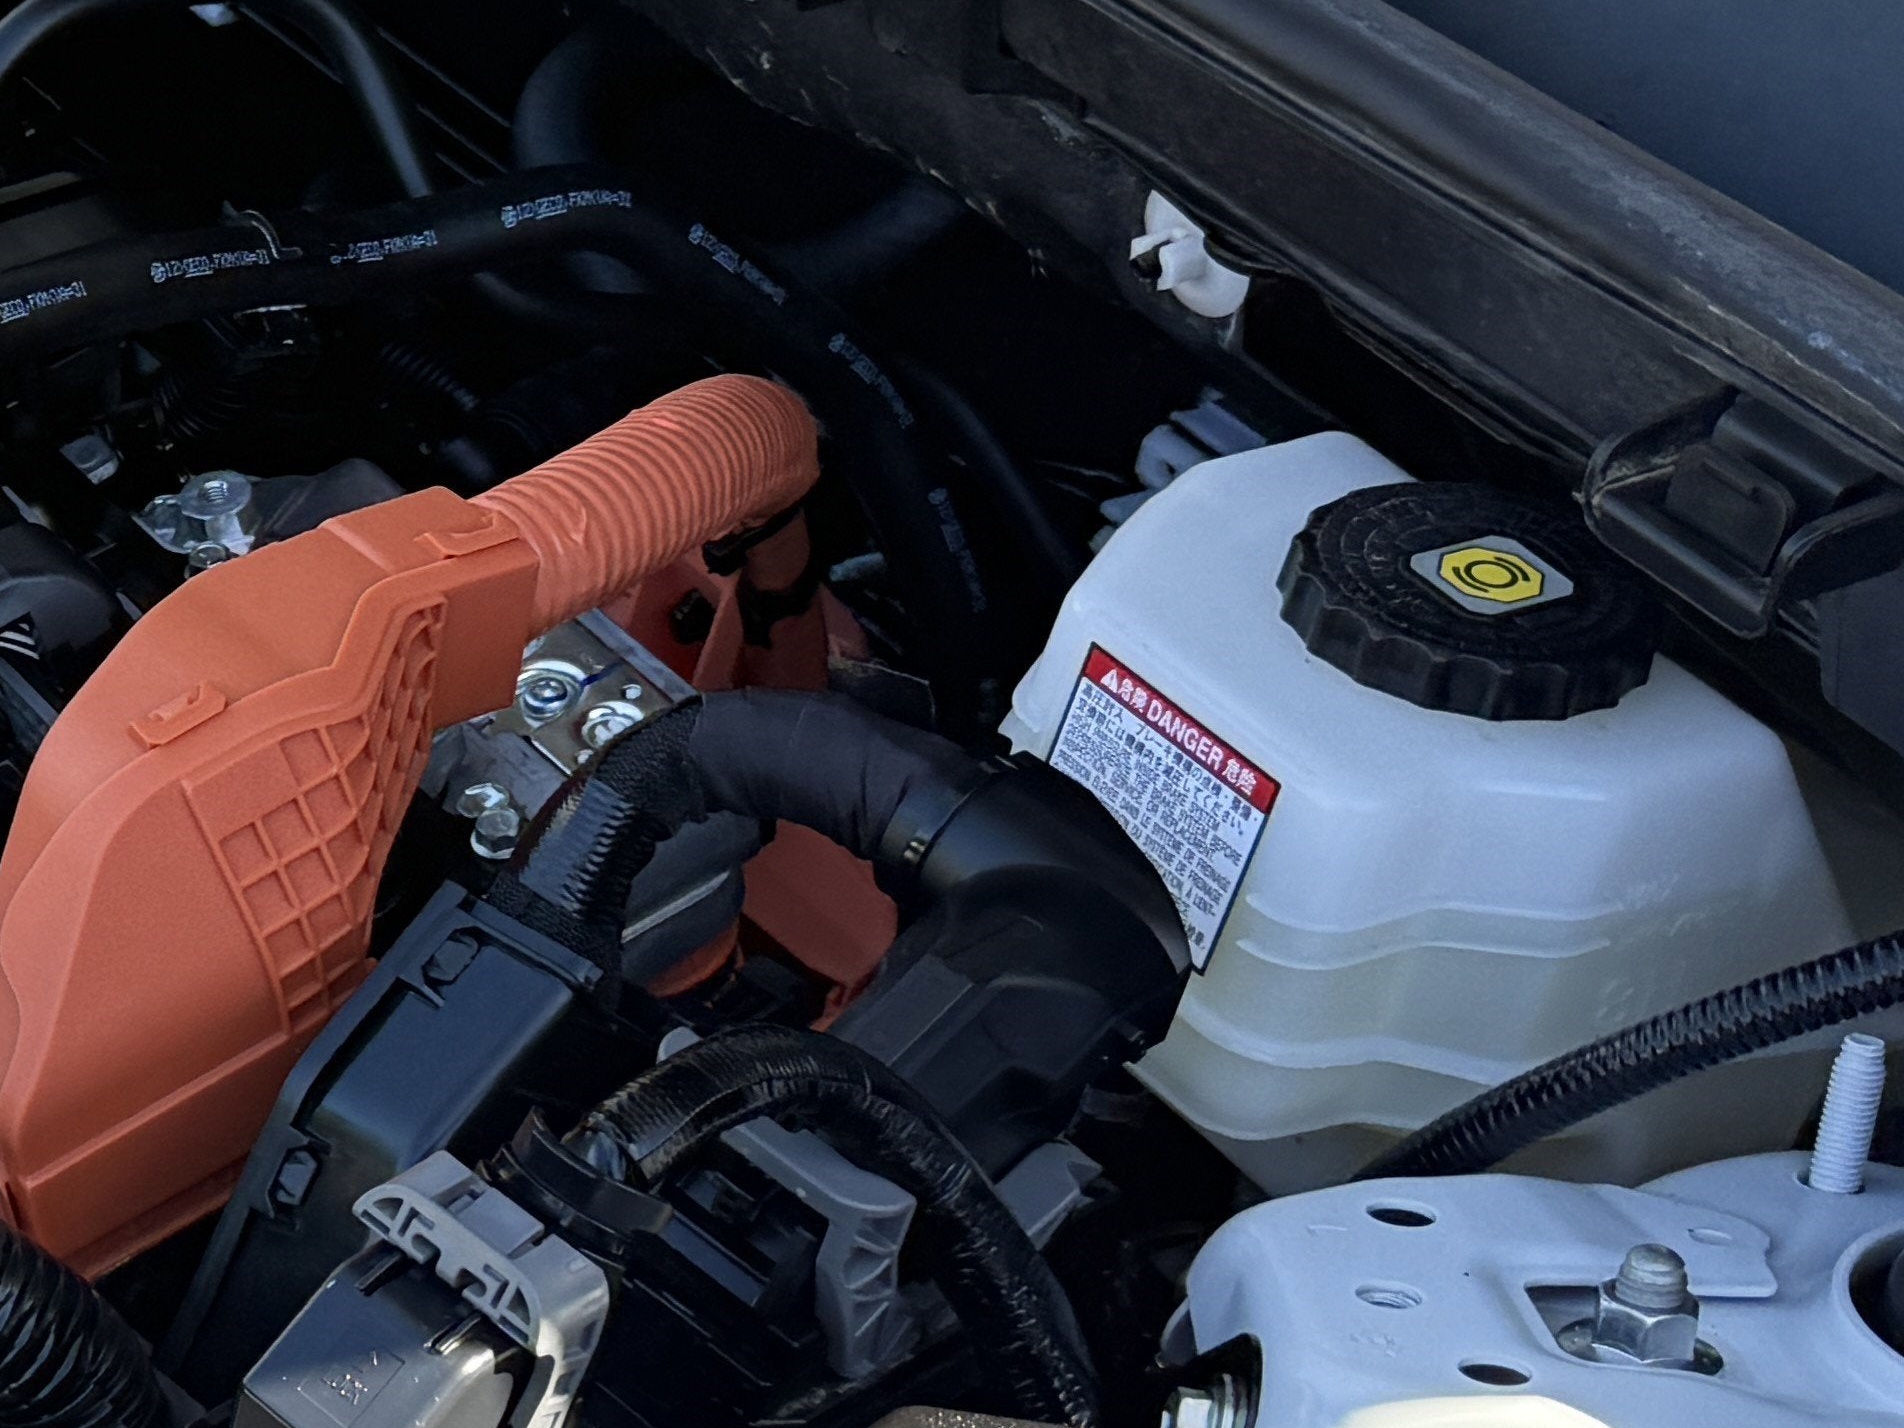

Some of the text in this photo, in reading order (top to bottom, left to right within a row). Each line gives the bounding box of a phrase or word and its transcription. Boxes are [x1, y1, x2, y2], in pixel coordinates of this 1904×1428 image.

[1144, 698, 1226, 771] DANGER
[1176, 808, 1211, 839] SYSTEM
[1187, 801, 1222, 832] SYSTEM
[1173, 859, 1188, 876] DE
[1182, 847, 1197, 864] DE
